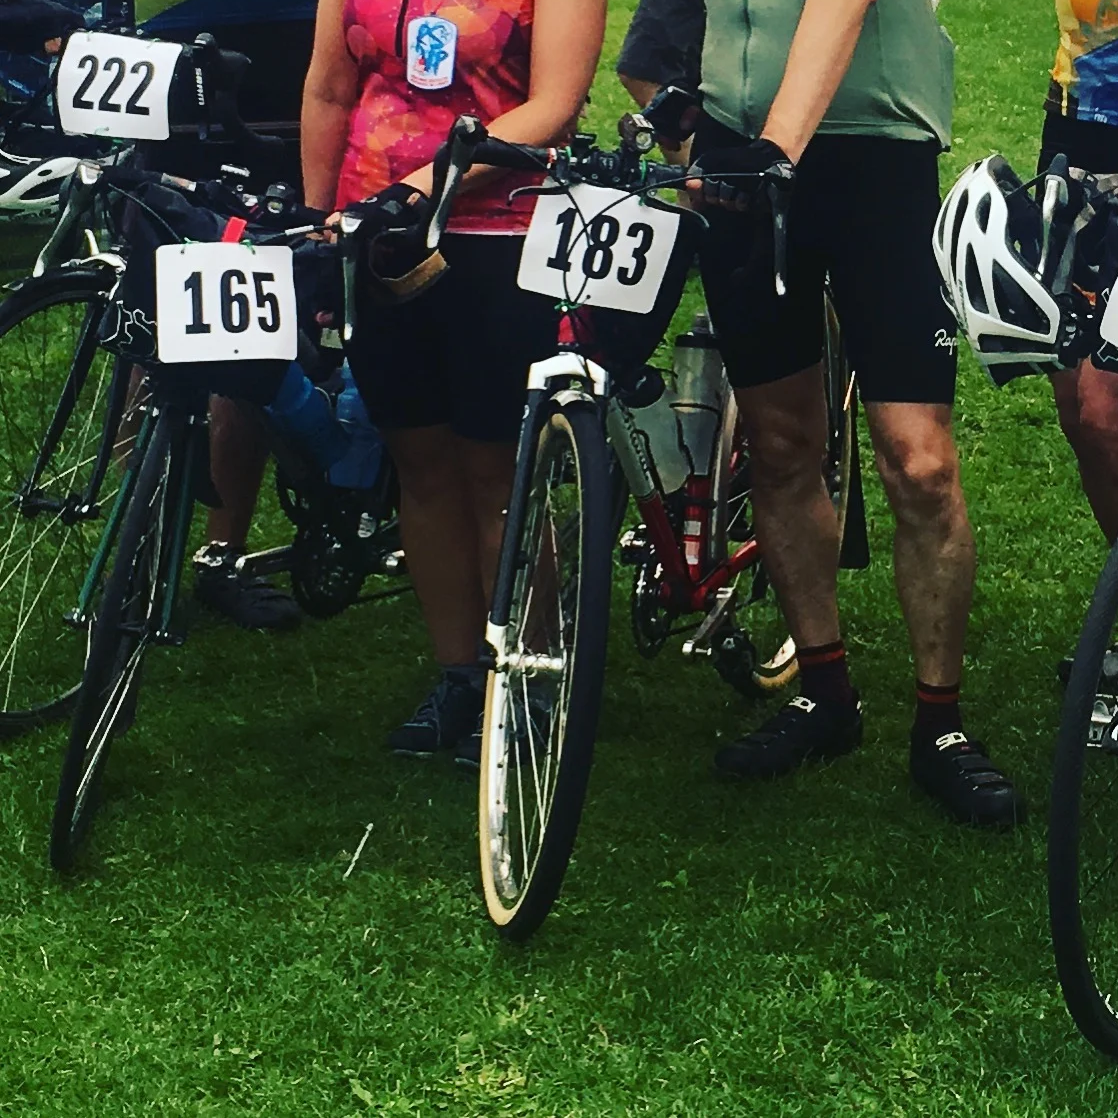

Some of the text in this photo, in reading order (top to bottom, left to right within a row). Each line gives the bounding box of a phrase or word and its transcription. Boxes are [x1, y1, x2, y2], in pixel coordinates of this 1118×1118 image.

[72, 54, 155, 116] 222
[546, 206, 655, 286] 183
[184, 268, 281, 335] 165
